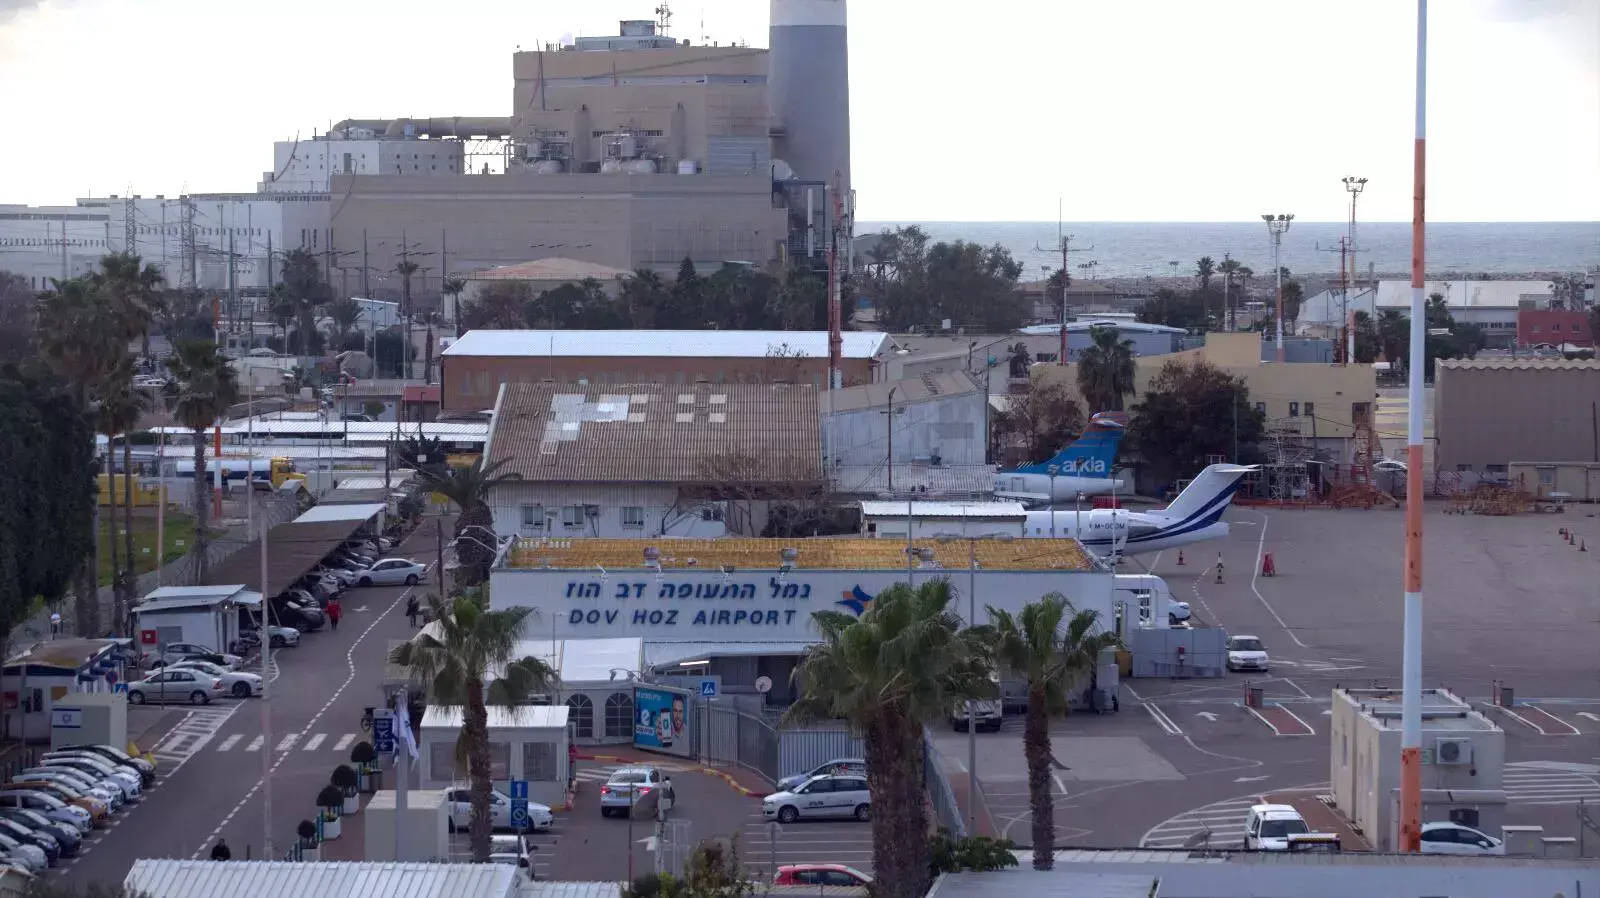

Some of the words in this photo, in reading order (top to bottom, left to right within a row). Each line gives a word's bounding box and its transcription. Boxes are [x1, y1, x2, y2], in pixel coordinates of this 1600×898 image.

[566, 583, 602, 599] הוז
[615, 583, 648, 599] דב
[658, 583, 756, 599] התעופה
[768, 576, 812, 599] נמל
[568, 609, 620, 625] DOV
[631, 609, 680, 625] HOZ
[692, 609, 798, 625] AIRPORT
